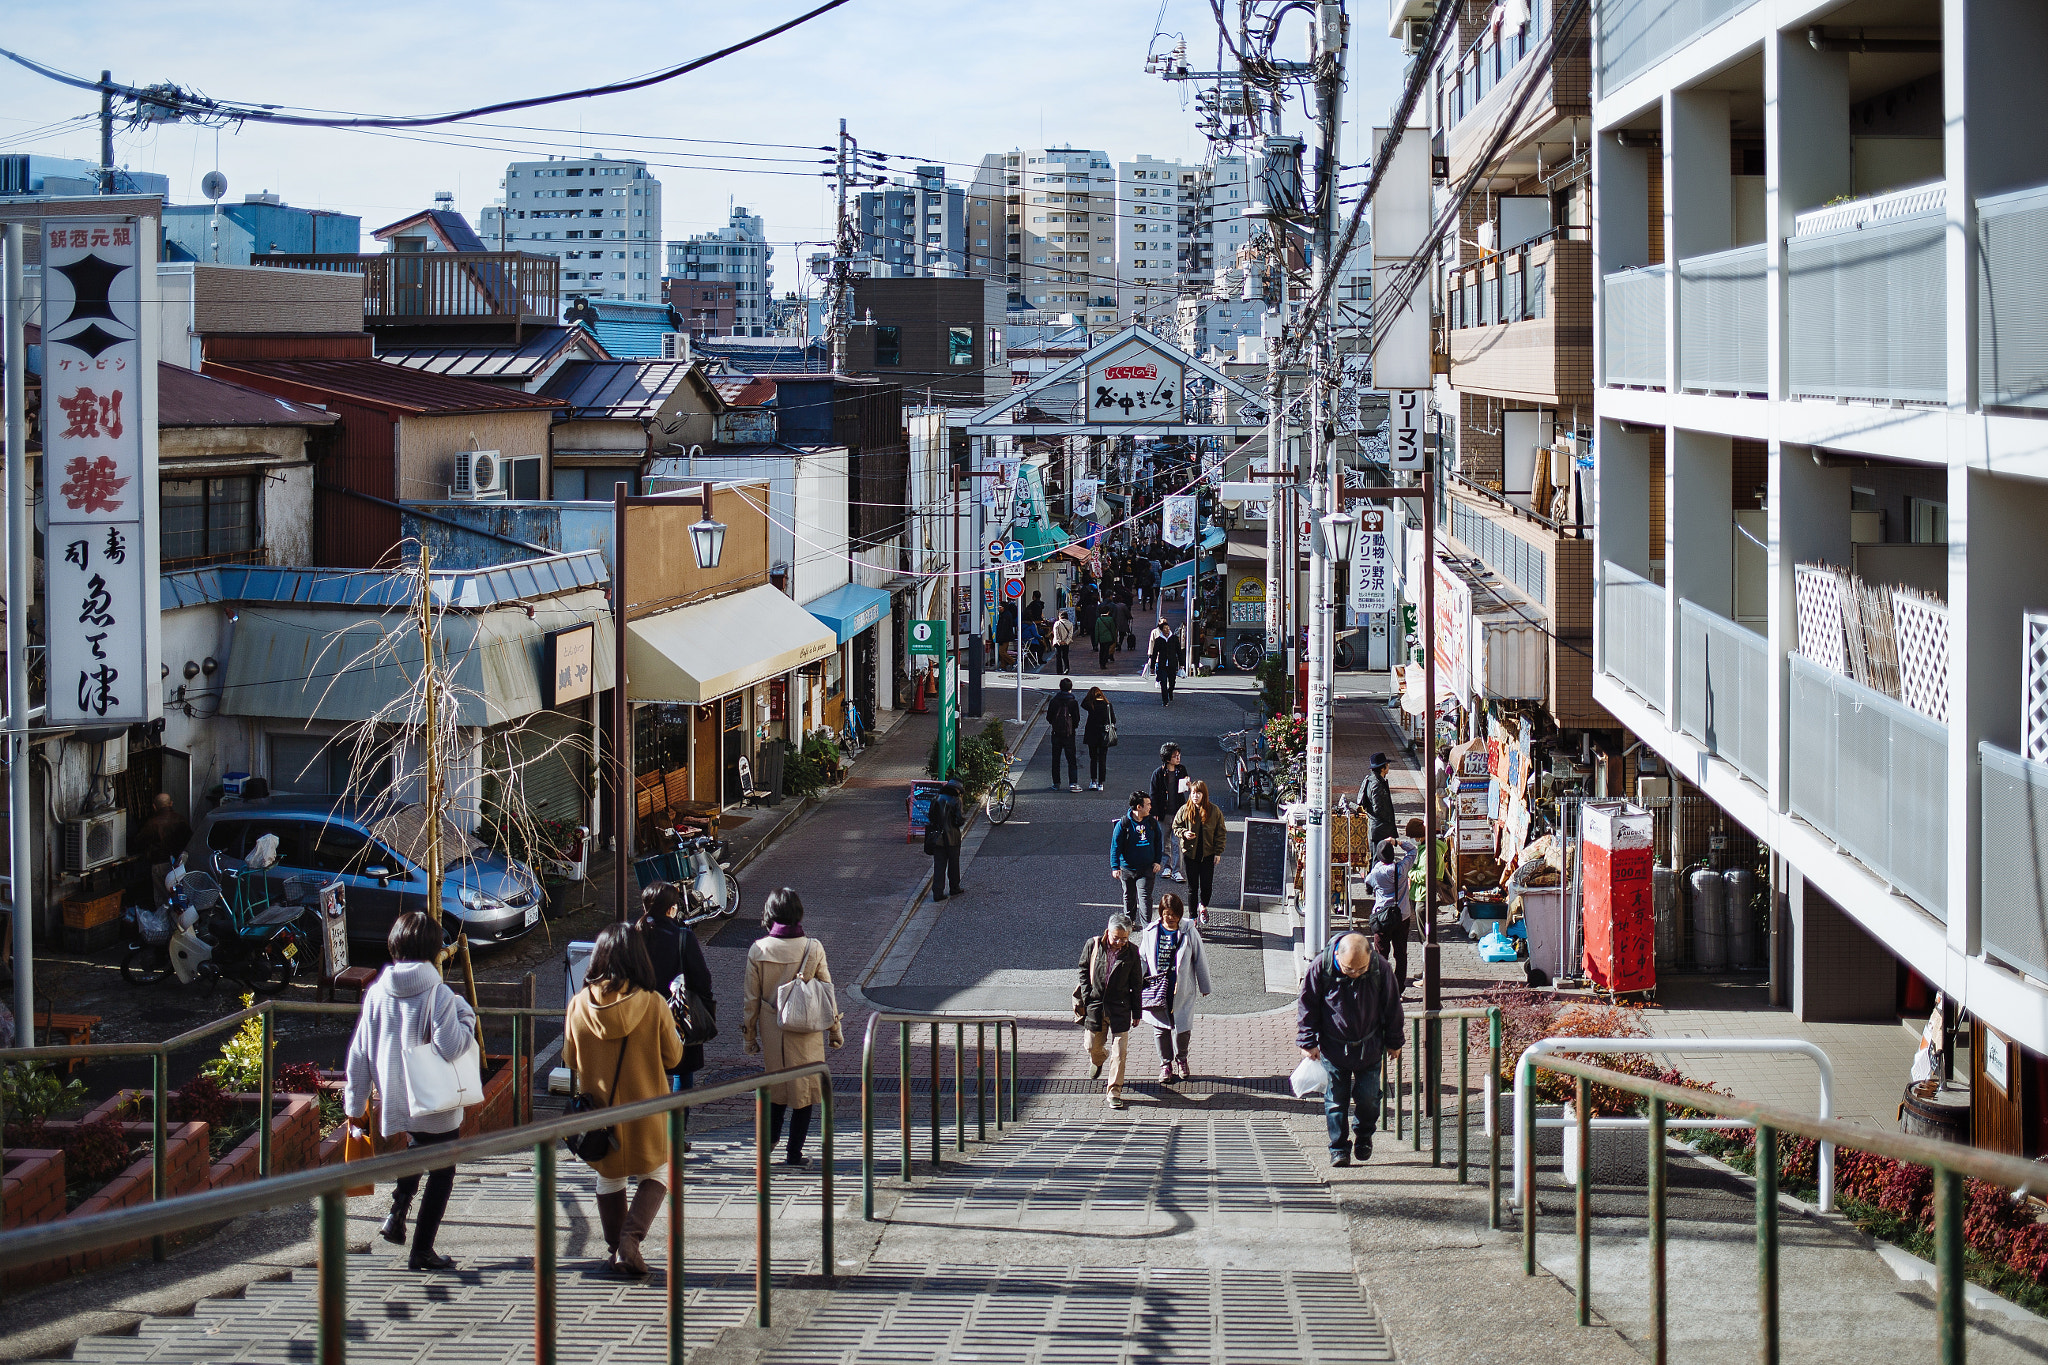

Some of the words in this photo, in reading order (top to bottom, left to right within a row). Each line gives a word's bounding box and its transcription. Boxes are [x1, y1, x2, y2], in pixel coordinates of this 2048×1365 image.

[59, 358, 126, 372] ケンビシ
[1105, 363, 1157, 380] ひぐらしの里
[1094, 376, 1176, 416] 谷中ぎんざ
[1399, 390, 1417, 462] リーマン
[1360, 534, 1371, 590] クリニック
[1372, 534, 1385, 590] 動物・野沢
[1616, 917, 1639, 978] 地ビール
[1630, 888, 1650, 982] 東京・谷中の
